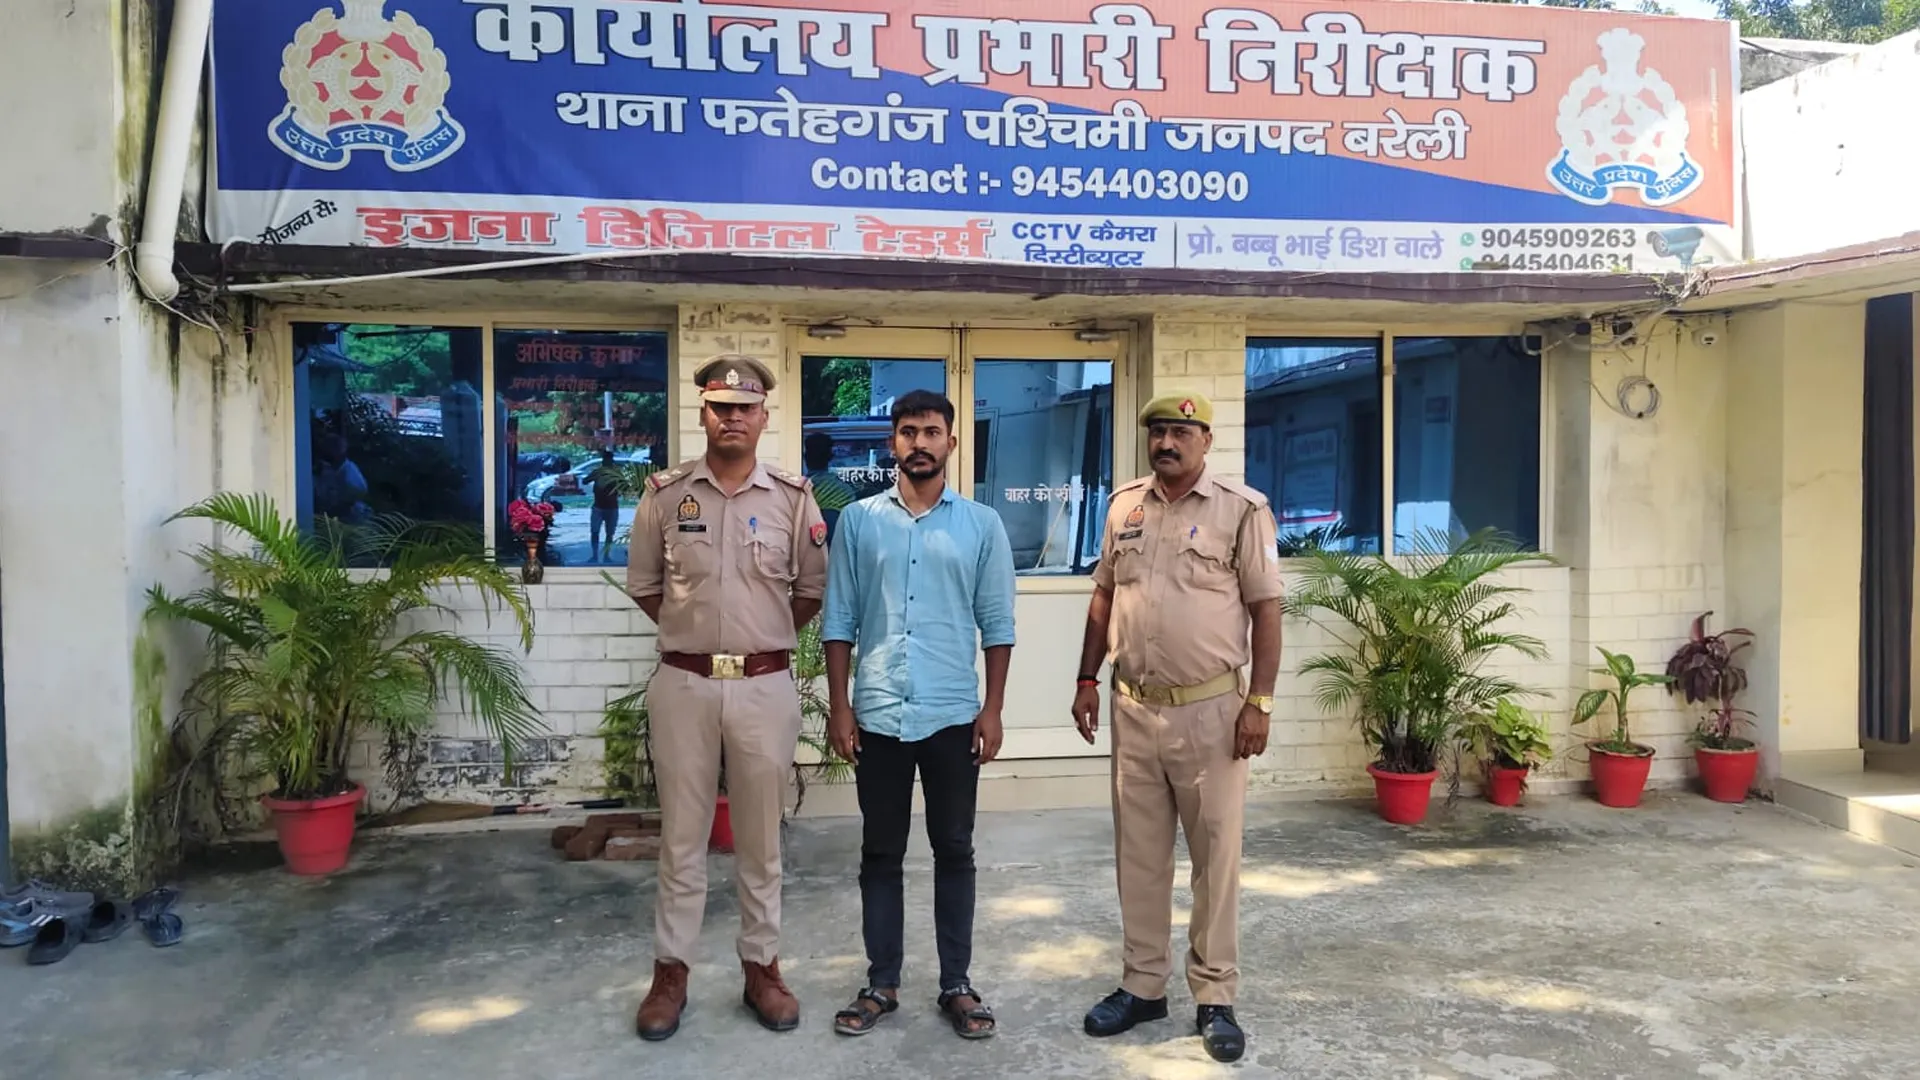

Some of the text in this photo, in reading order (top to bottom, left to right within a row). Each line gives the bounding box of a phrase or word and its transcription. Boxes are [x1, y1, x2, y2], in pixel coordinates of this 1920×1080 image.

[915, 4, 1173, 90] प्रभारी
[1196, 8, 1545, 101] निरीक्षक
[556, 87, 1470, 161] थाना फतेहगंज पश्चिमी जनपद बरेली
[286, 123, 452, 163] उत्तर प्रदेश पुलिस
[810, 157, 968, 194] Contact
[1012, 165, 1249, 201] 9454403090
[1560, 165, 1694, 198] उत्तर प्रदेश पुलिस
[256, 210, 314, 244] सौजन्य
[577, 206, 838, 250] डिजिटल
[1012, 219, 1157, 242] CCTV कैमरा
[1481, 228, 1636, 248] 9045909263
[1232, 231, 1283, 267] बब्बू
[1285, 225, 1333, 260] भाई
[1338, 226, 1389, 260] डिश
[1394, 229, 1444, 261] वाले
[867, 464, 884, 483] को
[1005, 488, 1031, 504] बाहर
[1033, 483, 1052, 502] को
